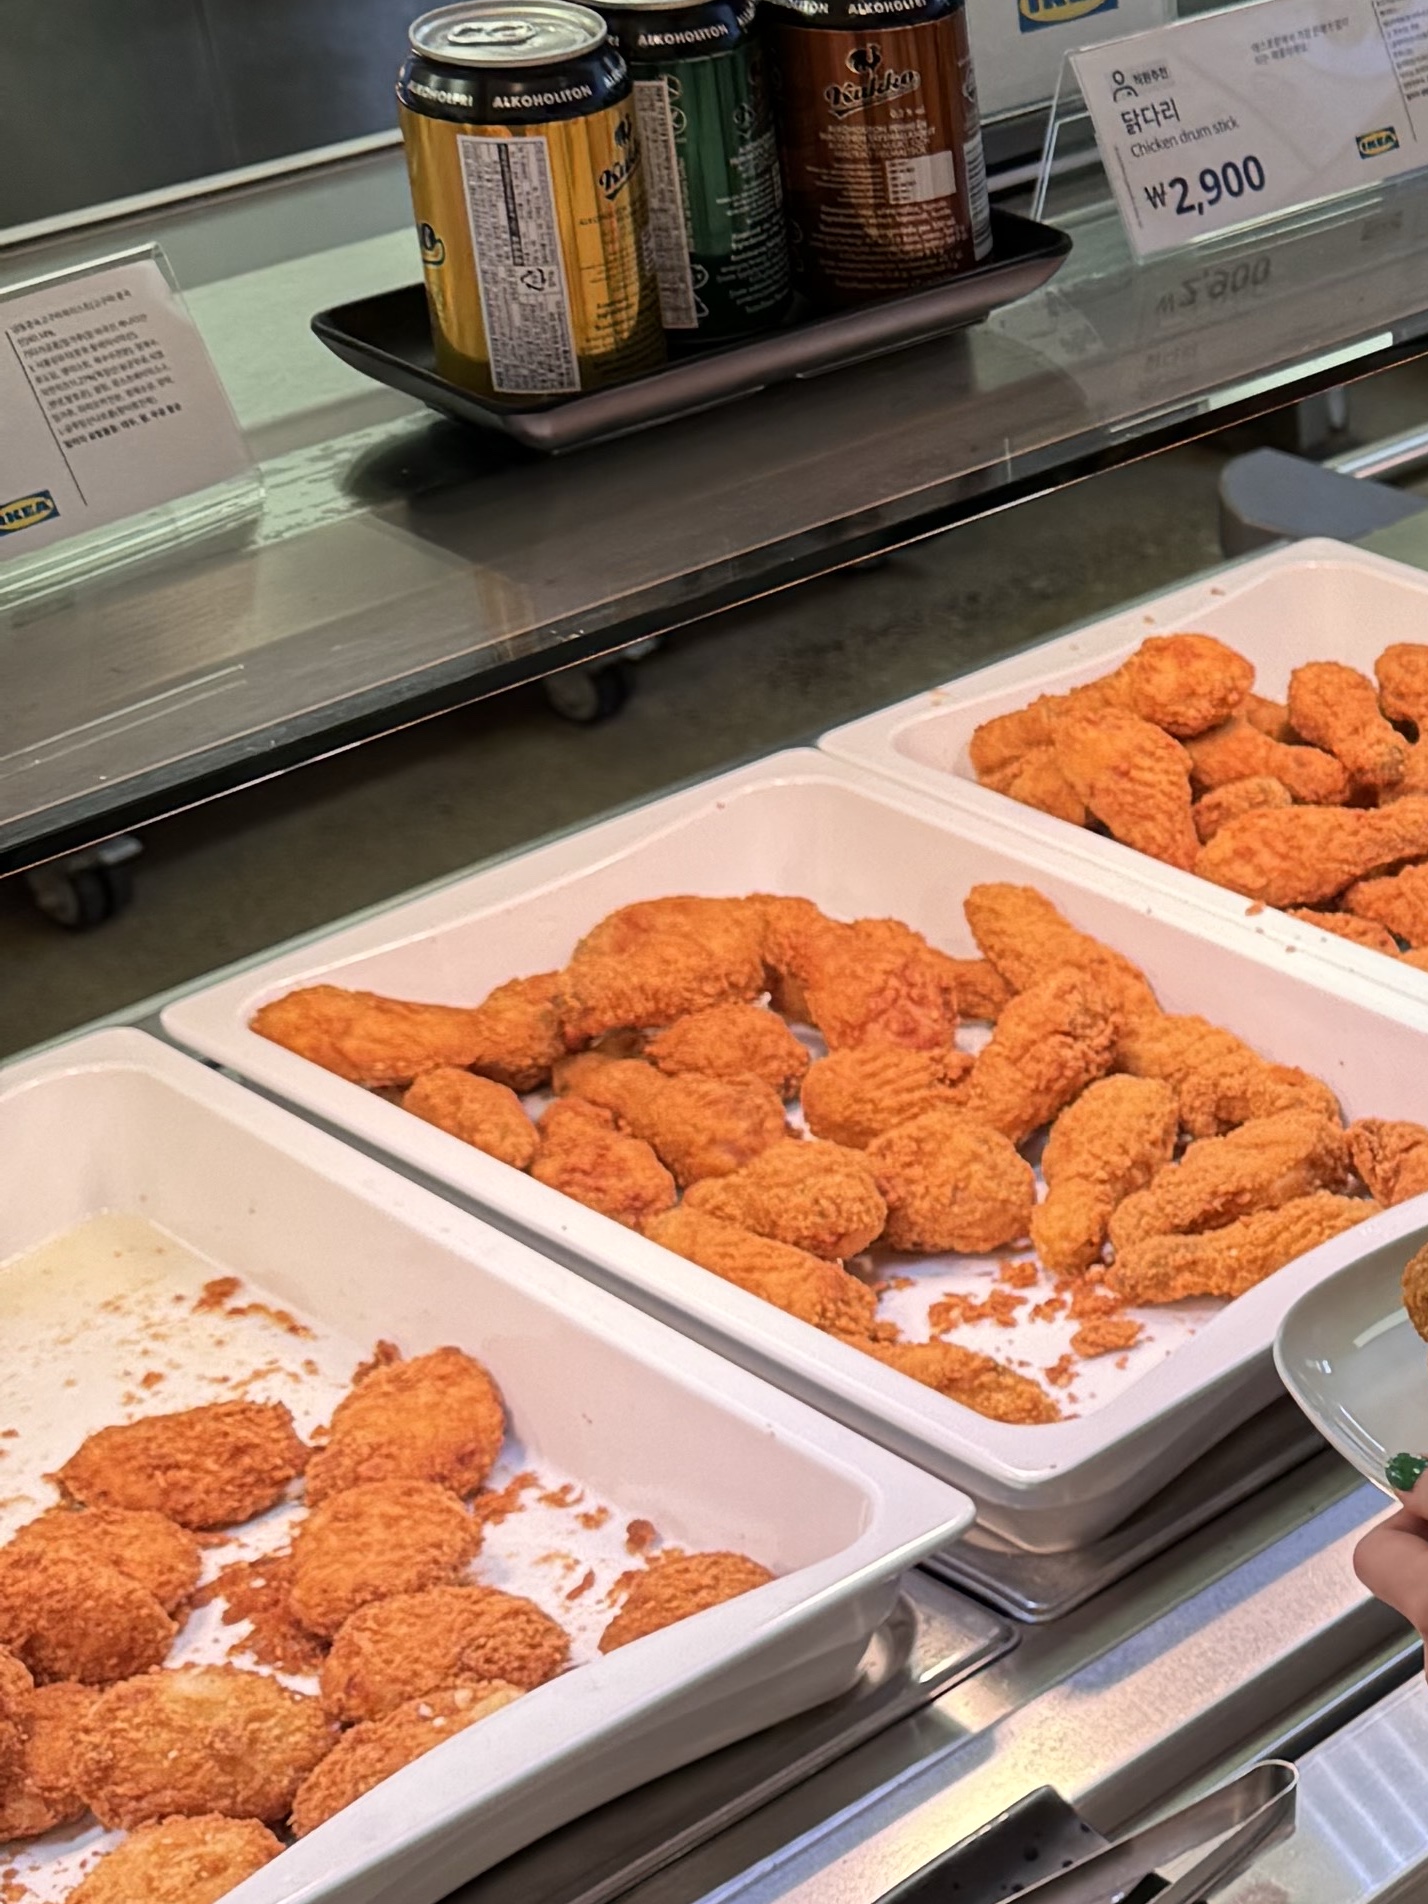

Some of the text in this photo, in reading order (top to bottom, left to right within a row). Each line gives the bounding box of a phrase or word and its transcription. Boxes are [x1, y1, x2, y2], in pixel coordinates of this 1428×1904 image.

[638, 23, 729, 47] ALKOHOLITON
[492, 84, 593, 109] ALKOHOLITON
[824, 66, 922, 108] Kukko
[1120, 97, 1181, 136] 닭다리
[1130, 115, 1240, 159] Chicken drum stick
[1361, 133, 1395, 152] IKEA
[1144, 155, 1266, 216] ₩2,900
